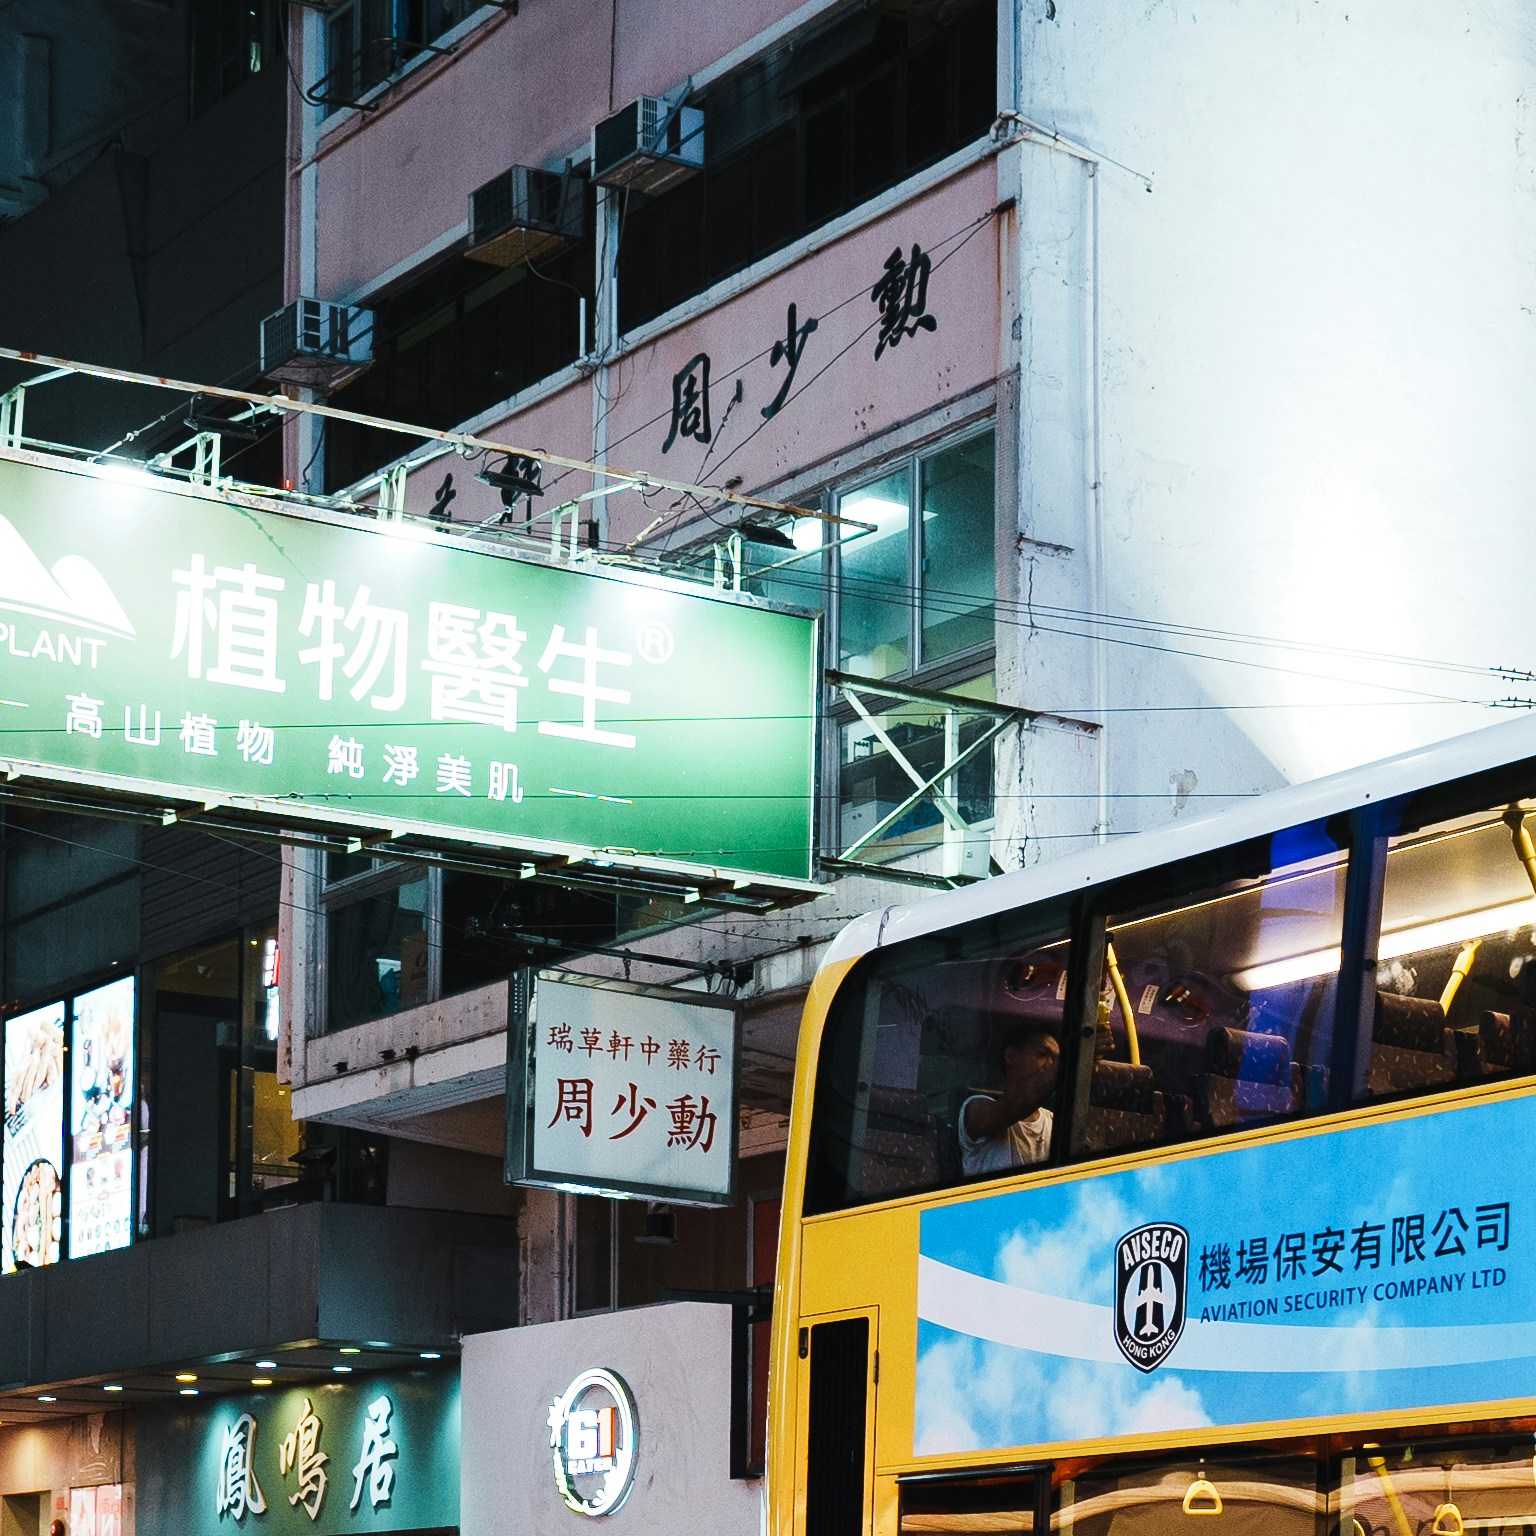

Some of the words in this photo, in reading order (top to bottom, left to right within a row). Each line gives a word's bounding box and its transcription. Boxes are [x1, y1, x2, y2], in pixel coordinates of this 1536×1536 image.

[663, 243, 937, 454] 周少勳
[169, 552, 637, 749] 植物醫生
[64, 692, 275, 768] 高山植物
[327, 734, 525, 804] 純淨美肌
[546, 1021, 723, 1076] 瑞草軒中藥行
[547, 1077, 718, 1154] 周少勳
[1122, 1230, 1183, 1271] AVSECO
[1197, 1200, 1512, 1293] 機場保安有限公司
[1199, 1297, 1279, 1324] AVIATION
[1283, 1284, 1368, 1314] SECURITY
[1372, 1273, 1465, 1303] COMPANY
[1470, 1267, 1507, 1290] LTD
[1122, 1334, 1148, 1359] HONG
[1149, 1329, 1176, 1358] KONG
[216, 1395, 400, 1521] 鳳鳴居
